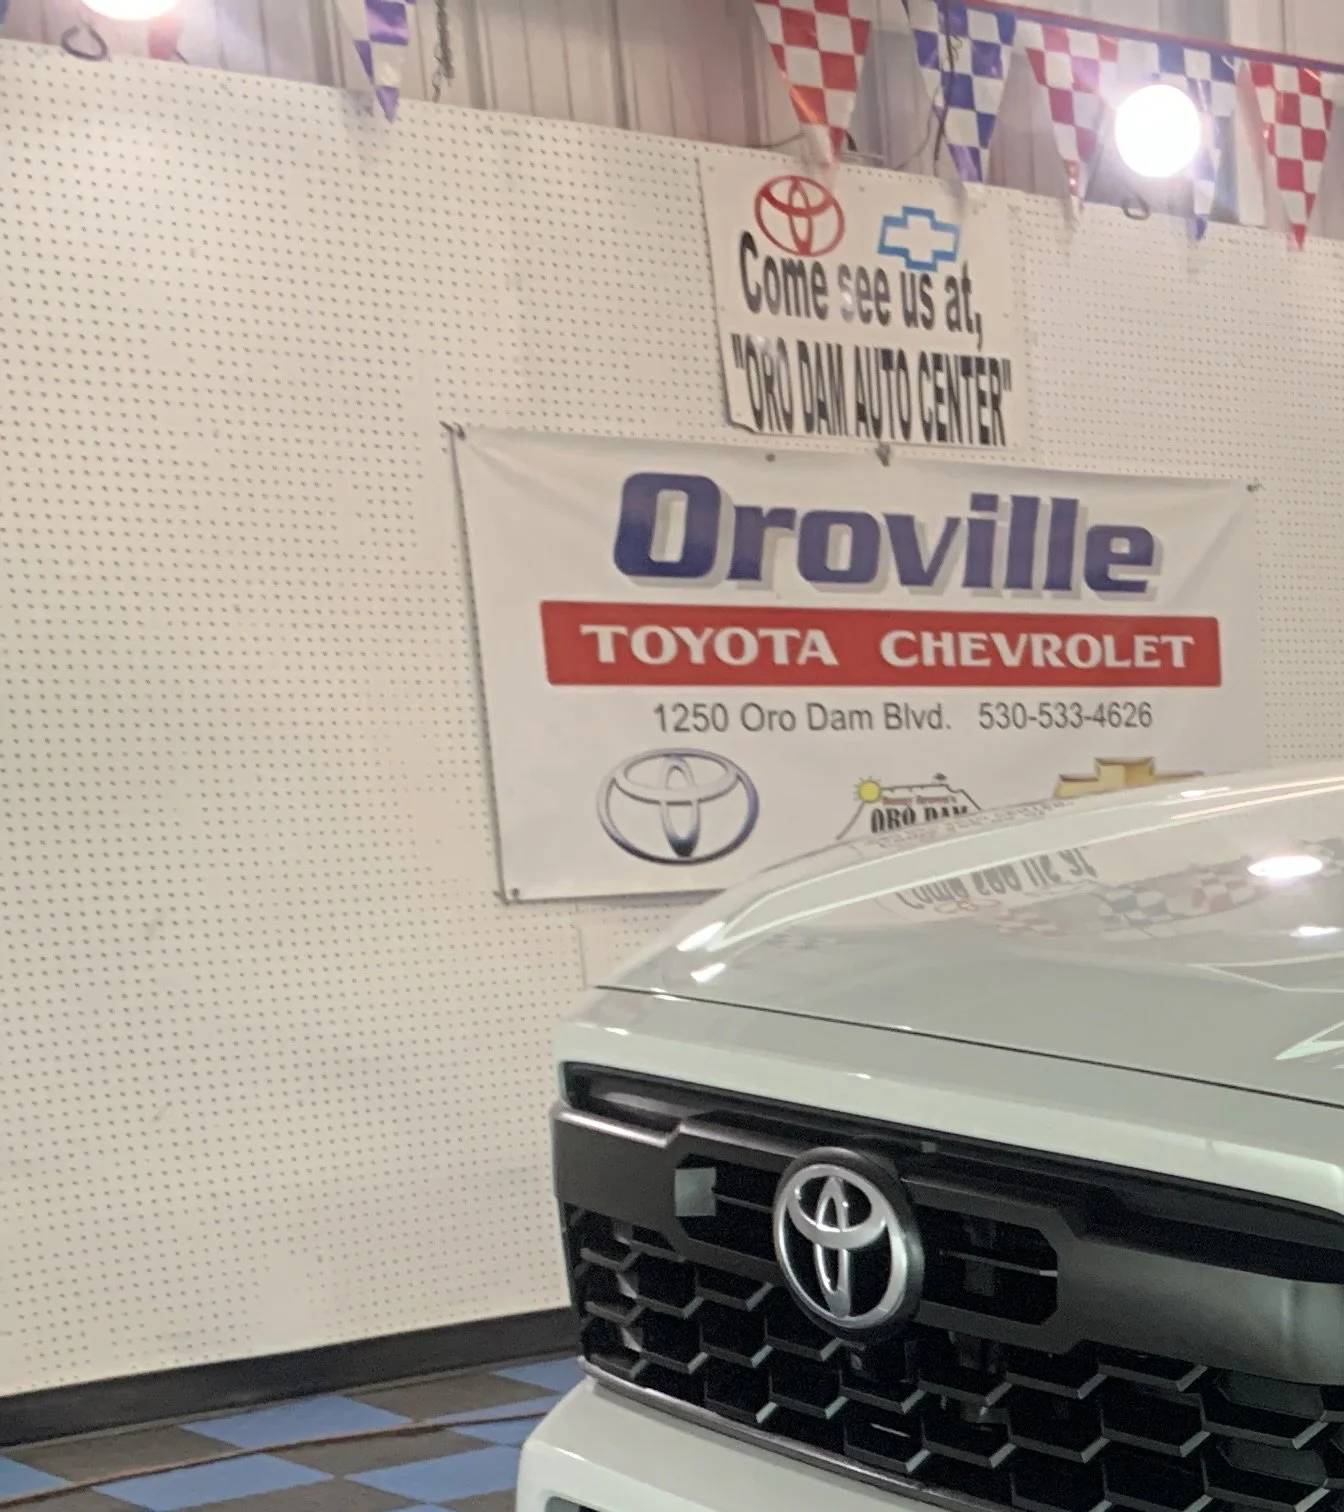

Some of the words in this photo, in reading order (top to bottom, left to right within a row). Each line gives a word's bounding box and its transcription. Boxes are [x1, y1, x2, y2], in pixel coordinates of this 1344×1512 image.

[740, 230, 828, 320] Come
[837, 264, 891, 327] see
[900, 271, 935, 330] us
[945, 260, 983, 351] at,
[797, 340, 847, 436] DAM
[854, 345, 911, 440] AUTO
[613, 471, 1160, 597] Oroville
[581, 623, 838, 666] TOYOTA
[881, 629, 1194, 669] CHEVROLET
[654, 702, 729, 734] 1250
[740, 702, 797, 734] Oro
[807, 702, 874, 733] Dam
[884, 701, 952, 732] Blvd.
[978, 701, 1153, 731] 530-533-4626
